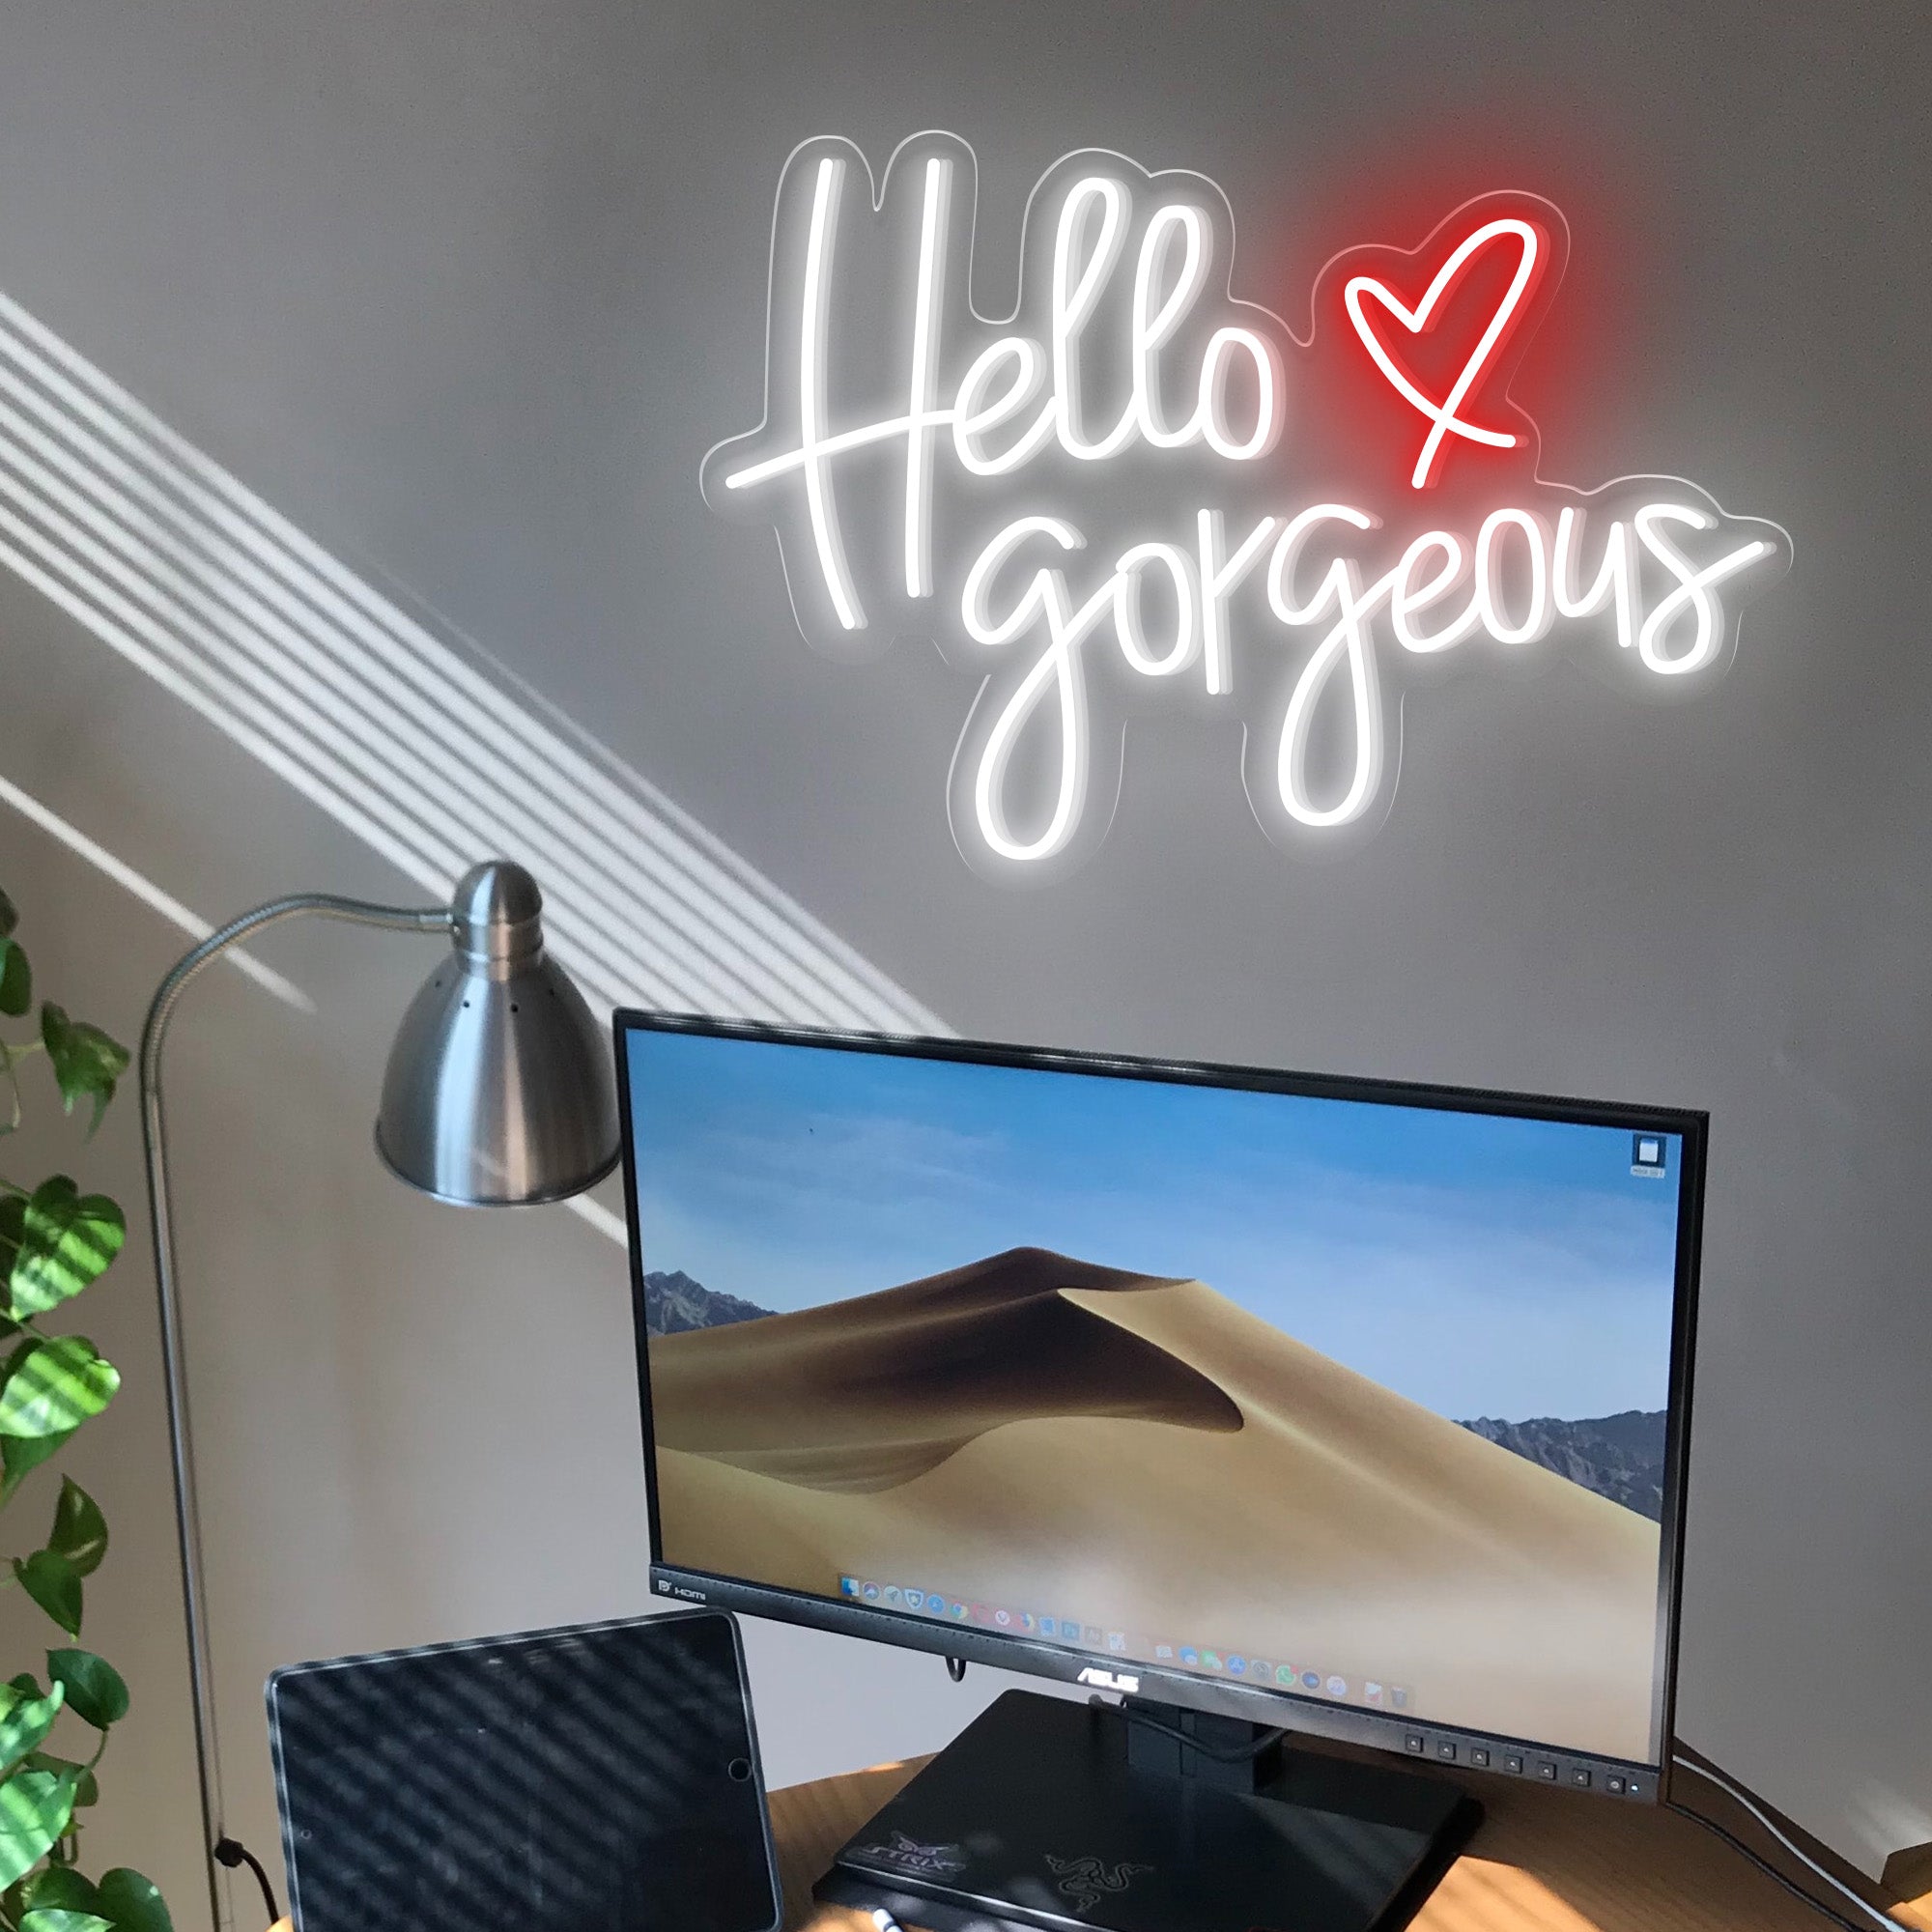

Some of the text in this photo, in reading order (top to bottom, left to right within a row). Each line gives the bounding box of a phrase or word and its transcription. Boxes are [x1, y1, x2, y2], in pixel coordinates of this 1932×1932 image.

[726, 156, 1287, 631] Hello
[960, 502, 1777, 862] gorgeous
[1077, 1666, 1139, 1692] ASUS
